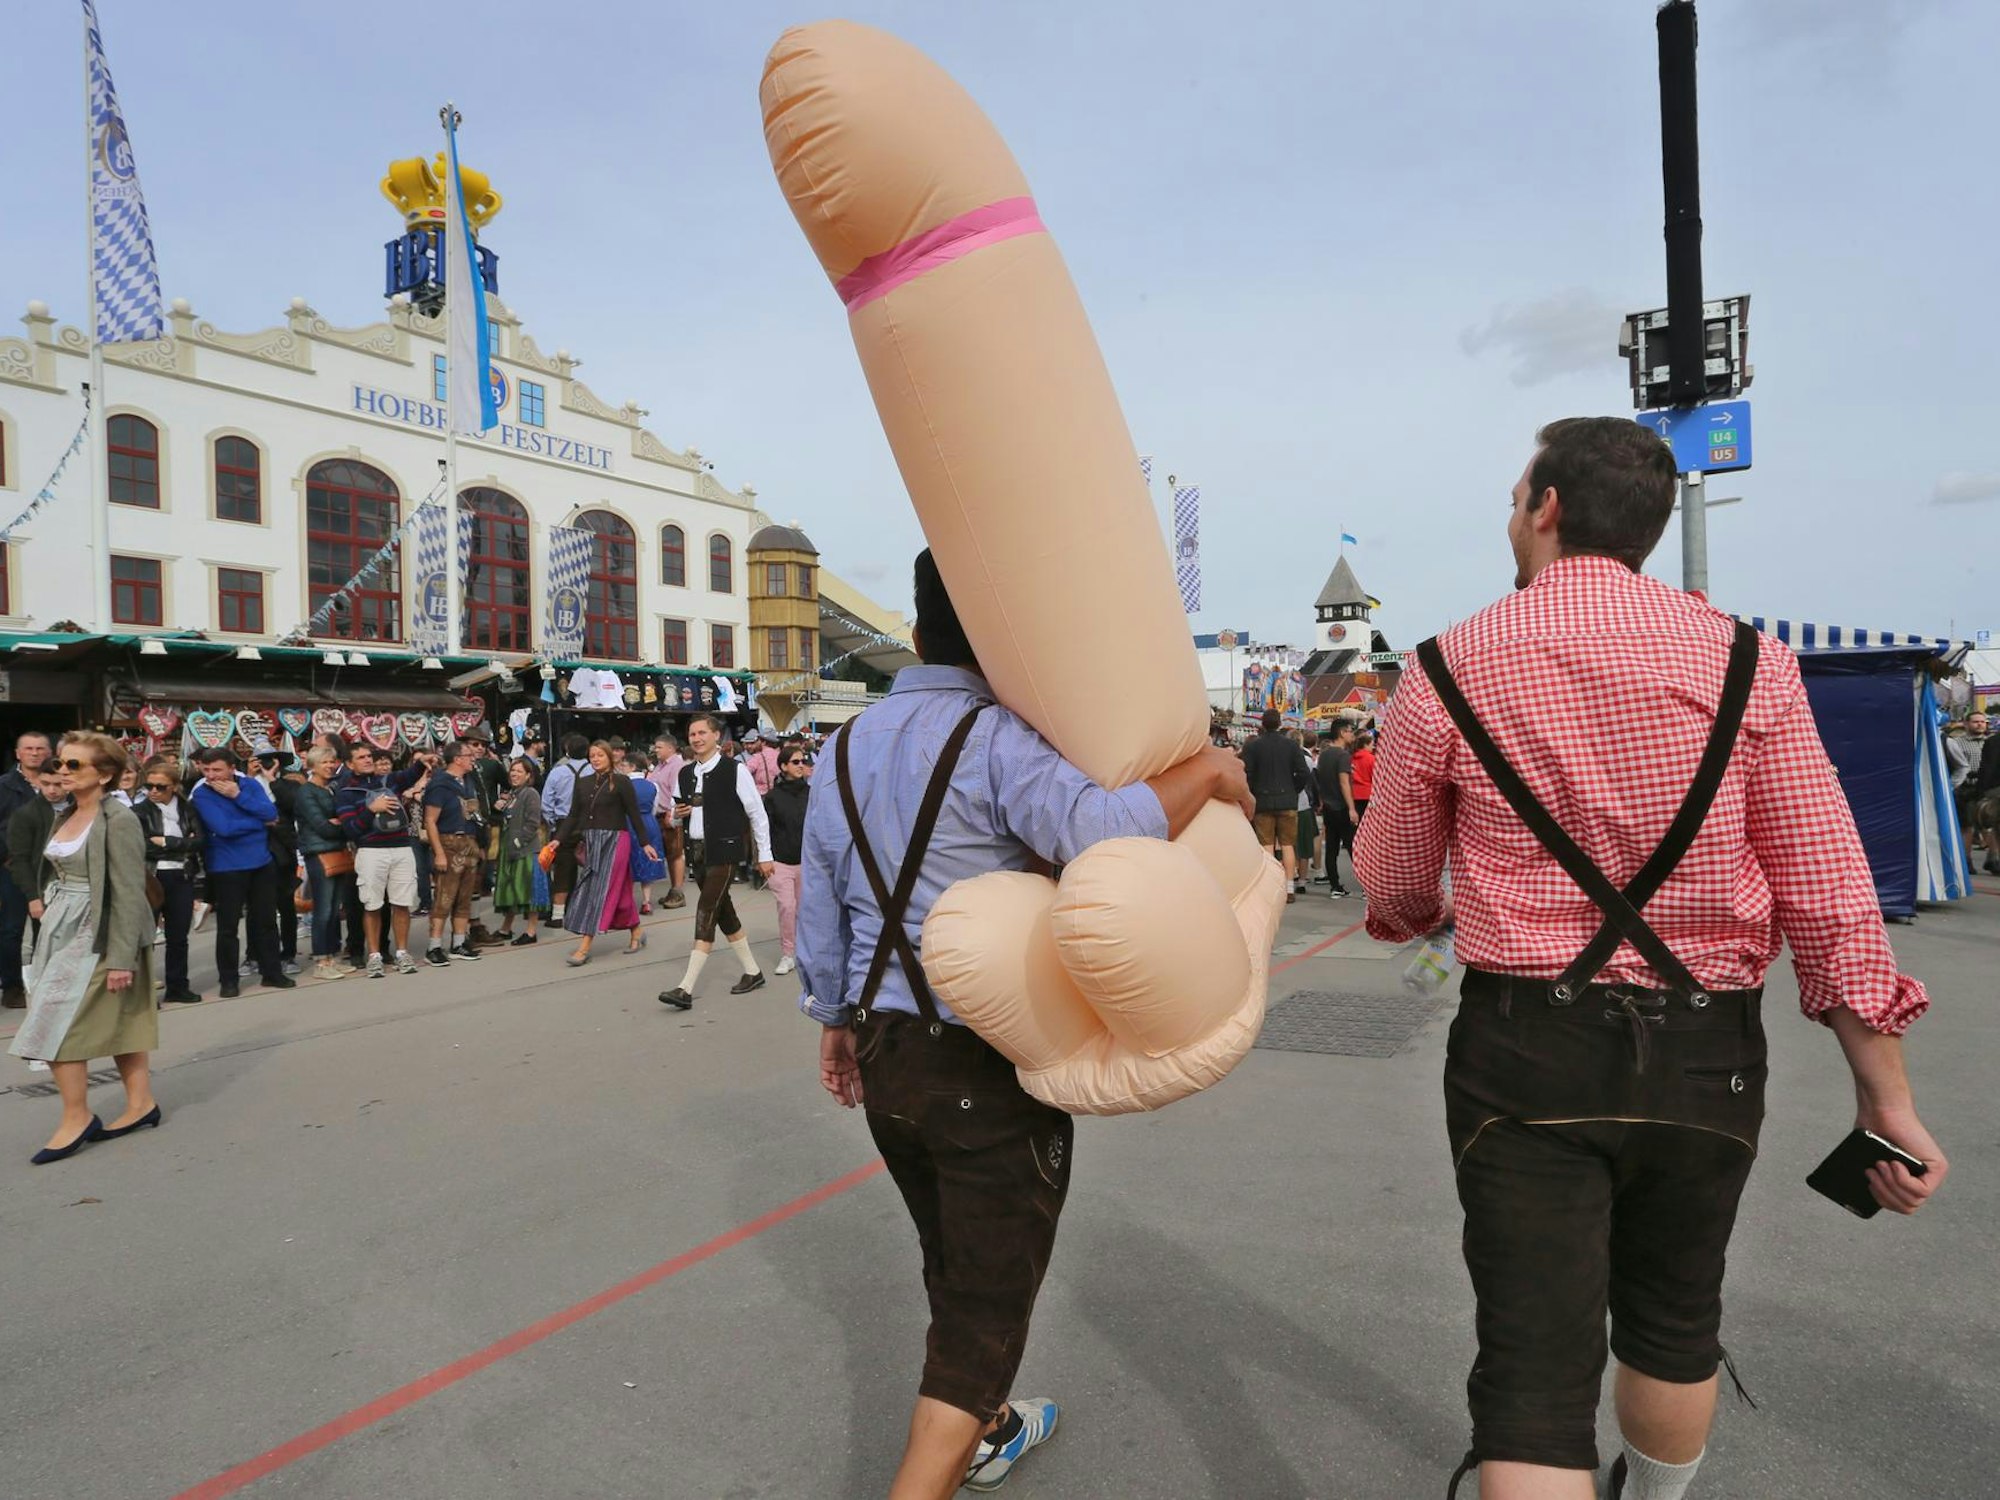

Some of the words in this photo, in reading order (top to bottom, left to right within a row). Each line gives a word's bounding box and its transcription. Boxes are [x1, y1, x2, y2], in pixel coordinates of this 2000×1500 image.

[353, 386, 488, 440] HOFBR
[501, 423, 612, 469] FESTZELT
[1714, 432, 1731, 442] U4
[1714, 449, 1732, 460] U5
[557, 610, 575, 628] HB
[1360, 652, 1414, 662] vinzenzm
